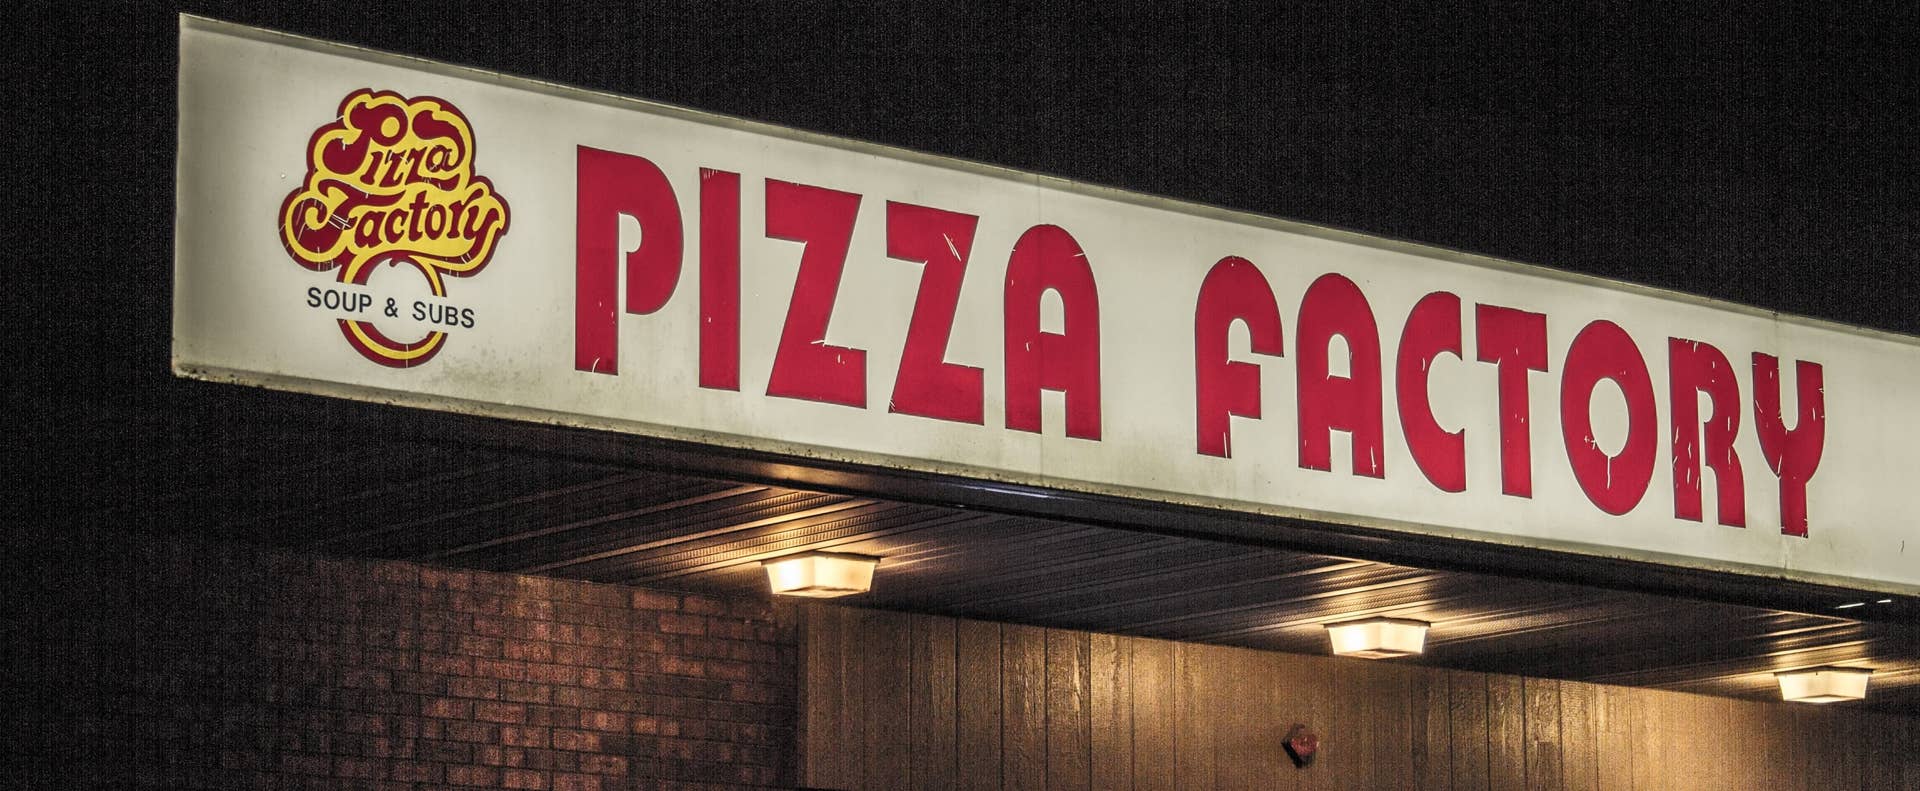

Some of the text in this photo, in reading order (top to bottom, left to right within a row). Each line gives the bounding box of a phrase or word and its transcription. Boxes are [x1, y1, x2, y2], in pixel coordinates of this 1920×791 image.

[322, 102, 464, 191] Pizza
[291, 178, 499, 264] Factory
[307, 287, 475, 328] SOUP & SUBS
[575, 145, 1825, 537] PIZZA FACTORY
